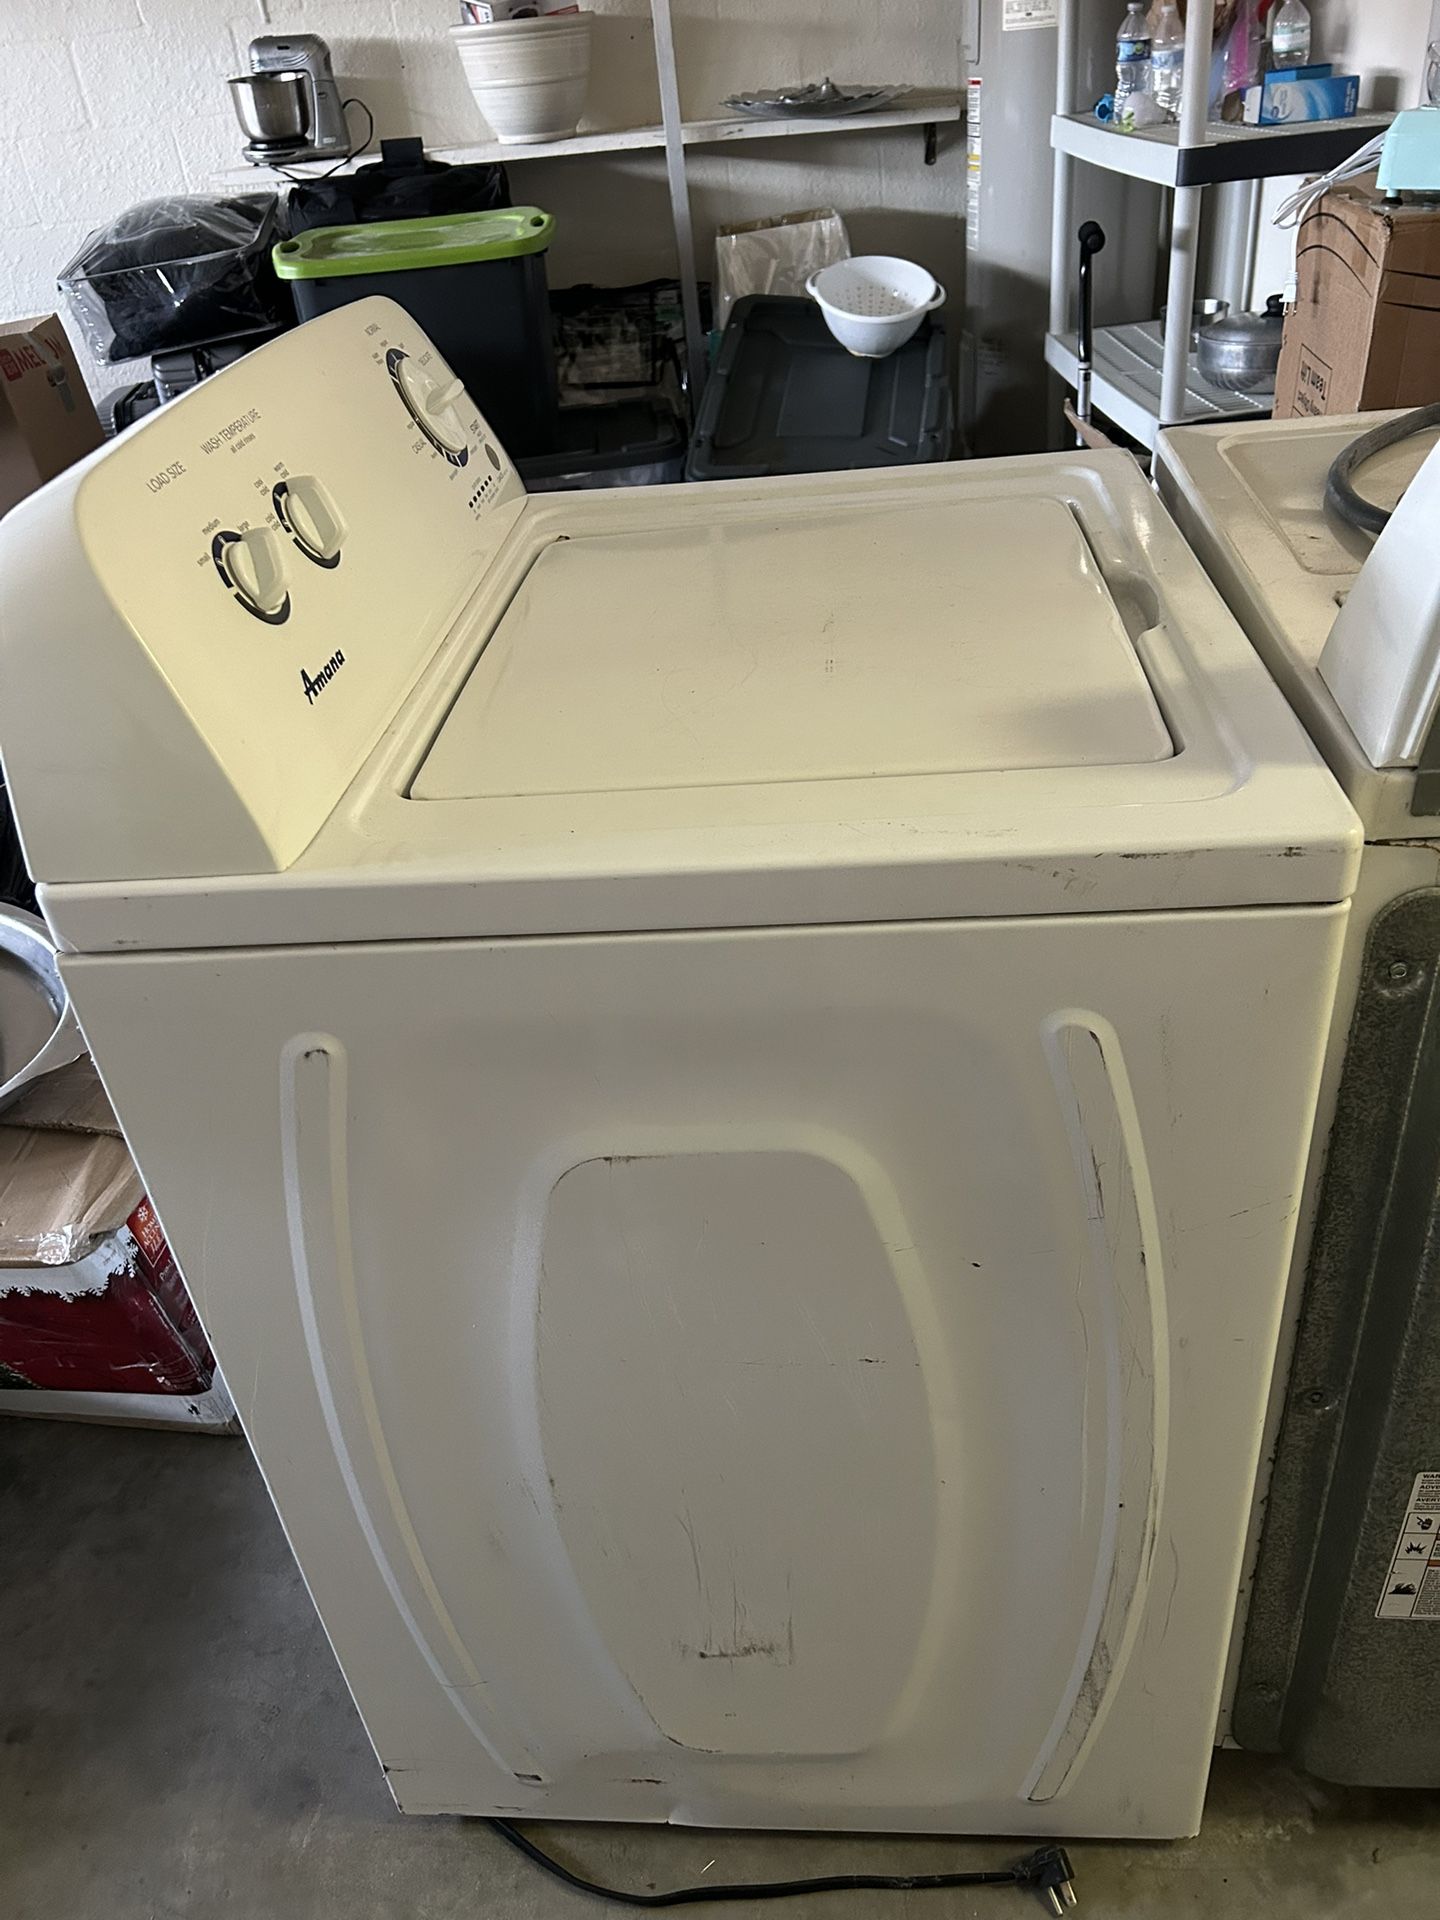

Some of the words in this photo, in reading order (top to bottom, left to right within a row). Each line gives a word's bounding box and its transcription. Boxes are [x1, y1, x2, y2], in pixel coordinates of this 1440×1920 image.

[200, 435, 223, 455] WASH
[218, 408, 262, 441] TEMPERATURE
[145, 471, 171, 493] LOAD
[166, 460, 187, 479] SIZE
[202, 518, 221, 536] medium
[197, 552, 211, 567] small
[300, 649, 346, 705] Amana
